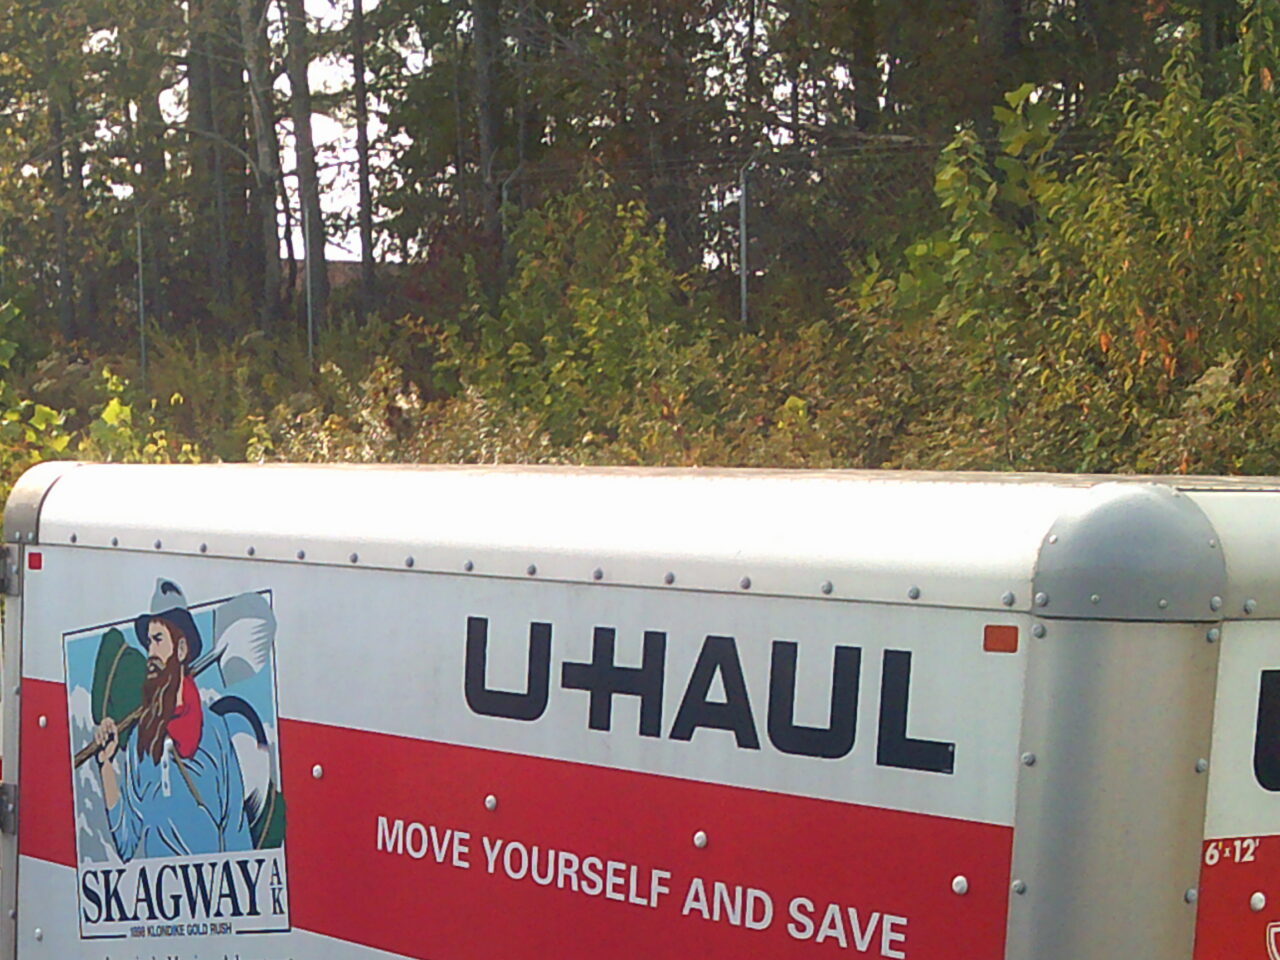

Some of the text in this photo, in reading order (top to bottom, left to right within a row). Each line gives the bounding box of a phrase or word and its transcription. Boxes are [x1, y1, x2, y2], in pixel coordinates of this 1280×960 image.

[463, 615, 956, 775] U-HAUL
[81, 858, 266, 924] SKAGWAY
[147, 924, 185, 938] KLONDIKE
[186, 923, 208, 936] GOLD
[210, 922, 232, 935] RUSH
[376, 815, 908, 960] MOVE YOURSELF AND SAVE
